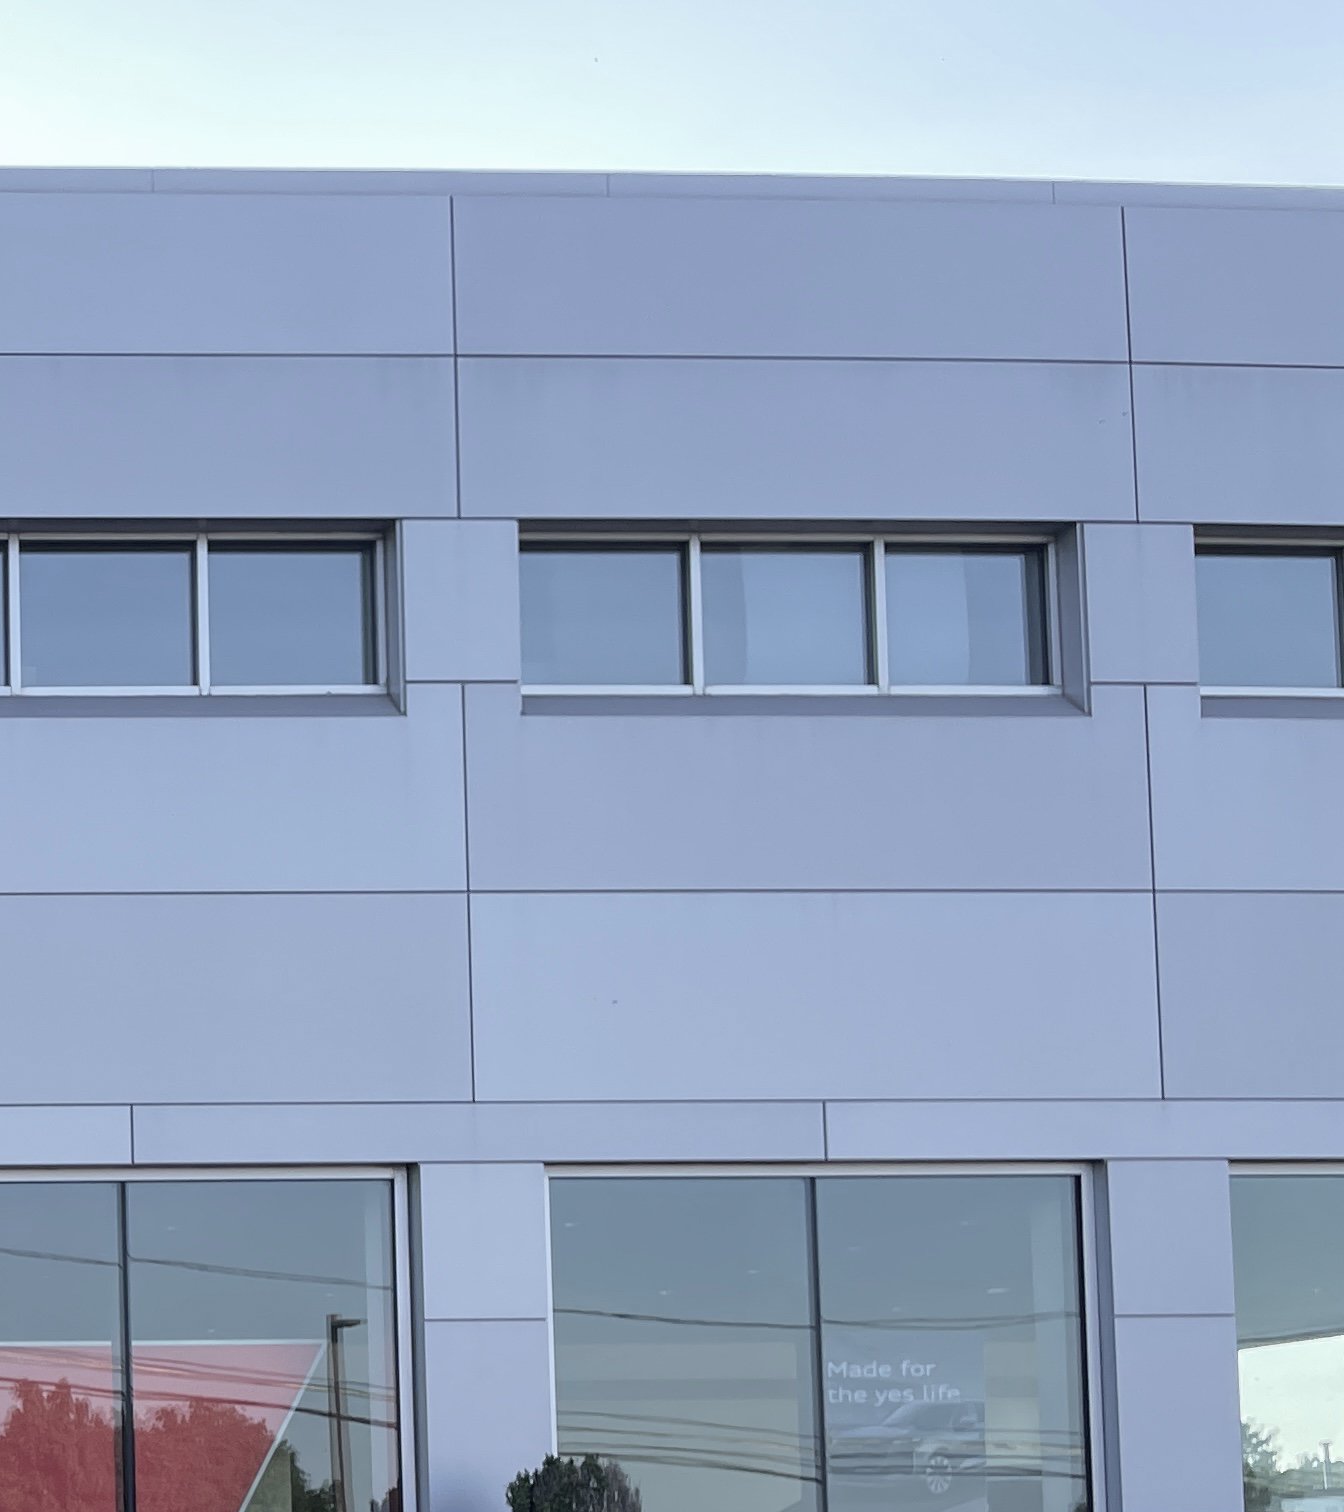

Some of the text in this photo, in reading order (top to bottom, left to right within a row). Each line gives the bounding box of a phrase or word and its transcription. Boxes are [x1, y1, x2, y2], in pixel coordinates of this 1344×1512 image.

[827, 1359, 937, 1378] Made for
[827, 1384, 961, 1407] the yes life
